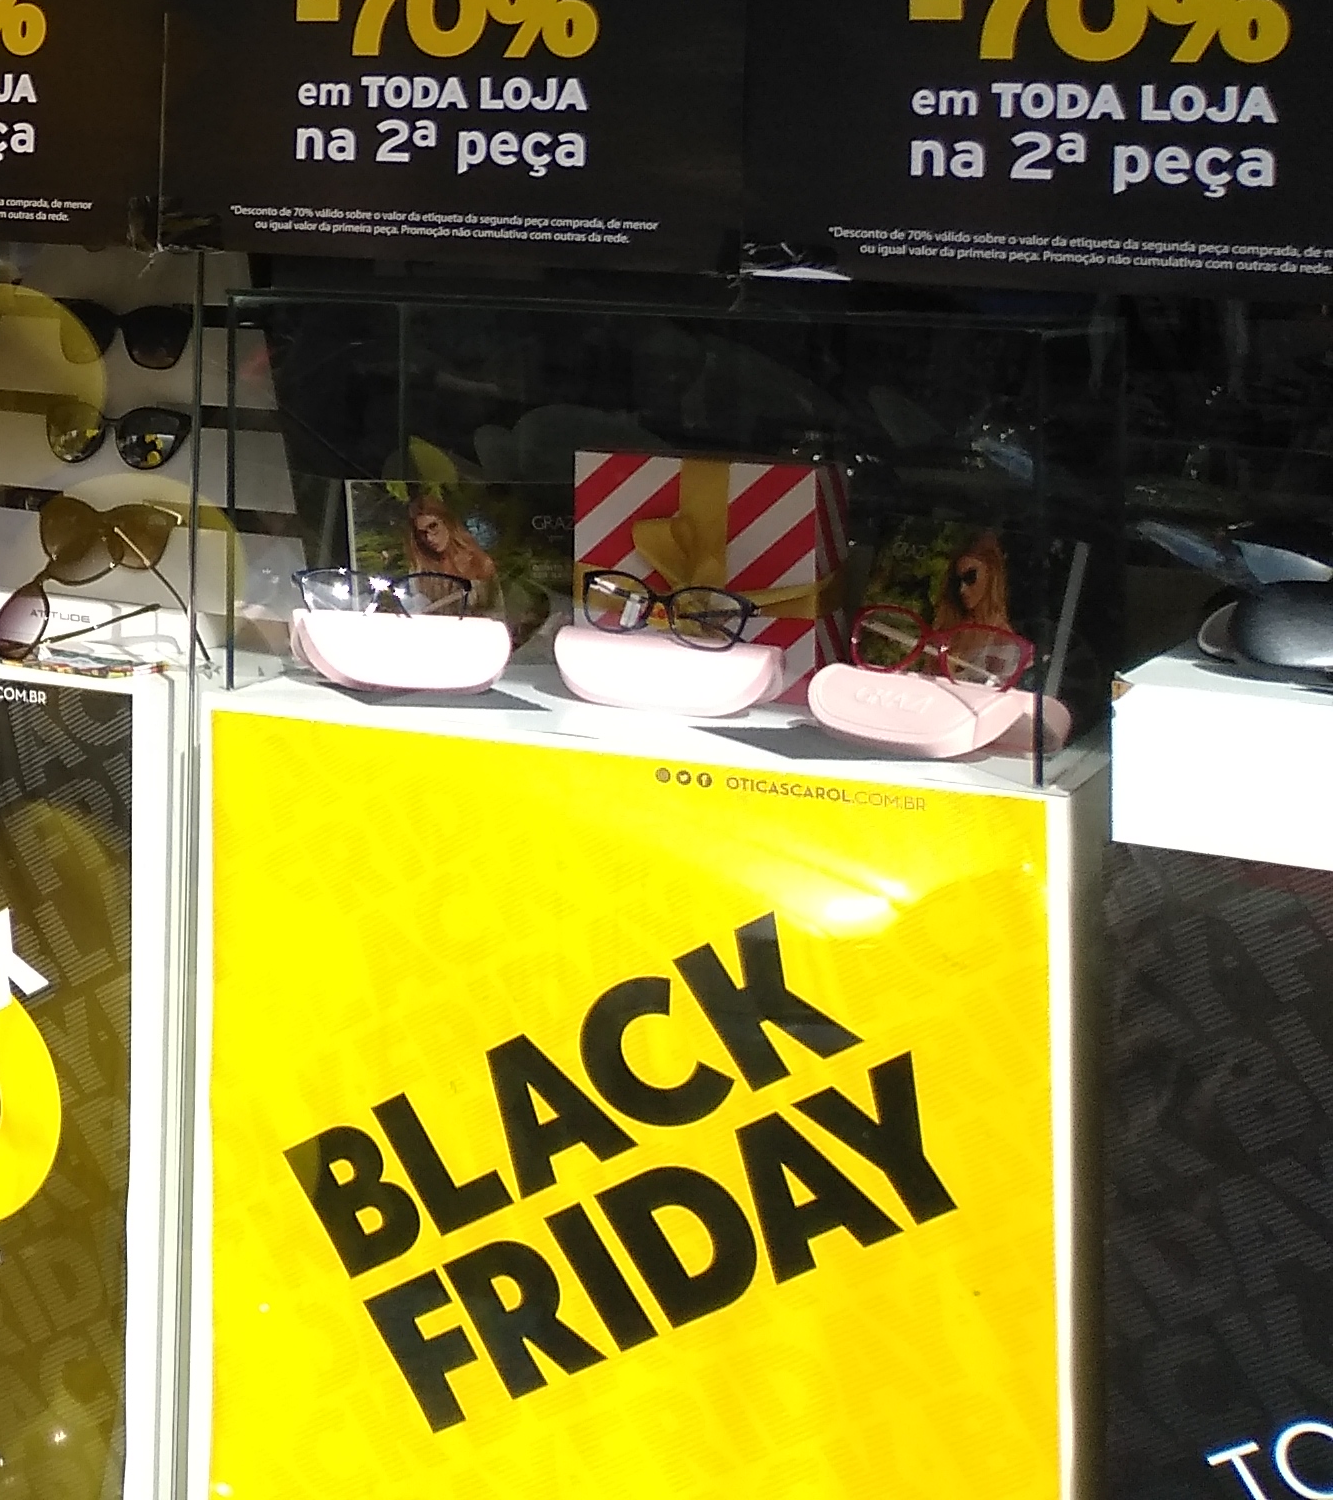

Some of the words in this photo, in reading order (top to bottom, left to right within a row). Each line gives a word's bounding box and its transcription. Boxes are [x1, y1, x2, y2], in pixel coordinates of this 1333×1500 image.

[298, 82, 351, 106] em
[360, 76, 469, 109] TODA
[479, 77, 588, 111] LOJA
[295, 127, 356, 161] na
[457, 130, 586, 177] peça
[725, 776, 926, 812] OTICASCAROL.COM.BR
[283, 911, 863, 1278] BLACK
[363, 1050, 958, 1434] FRIDAY
